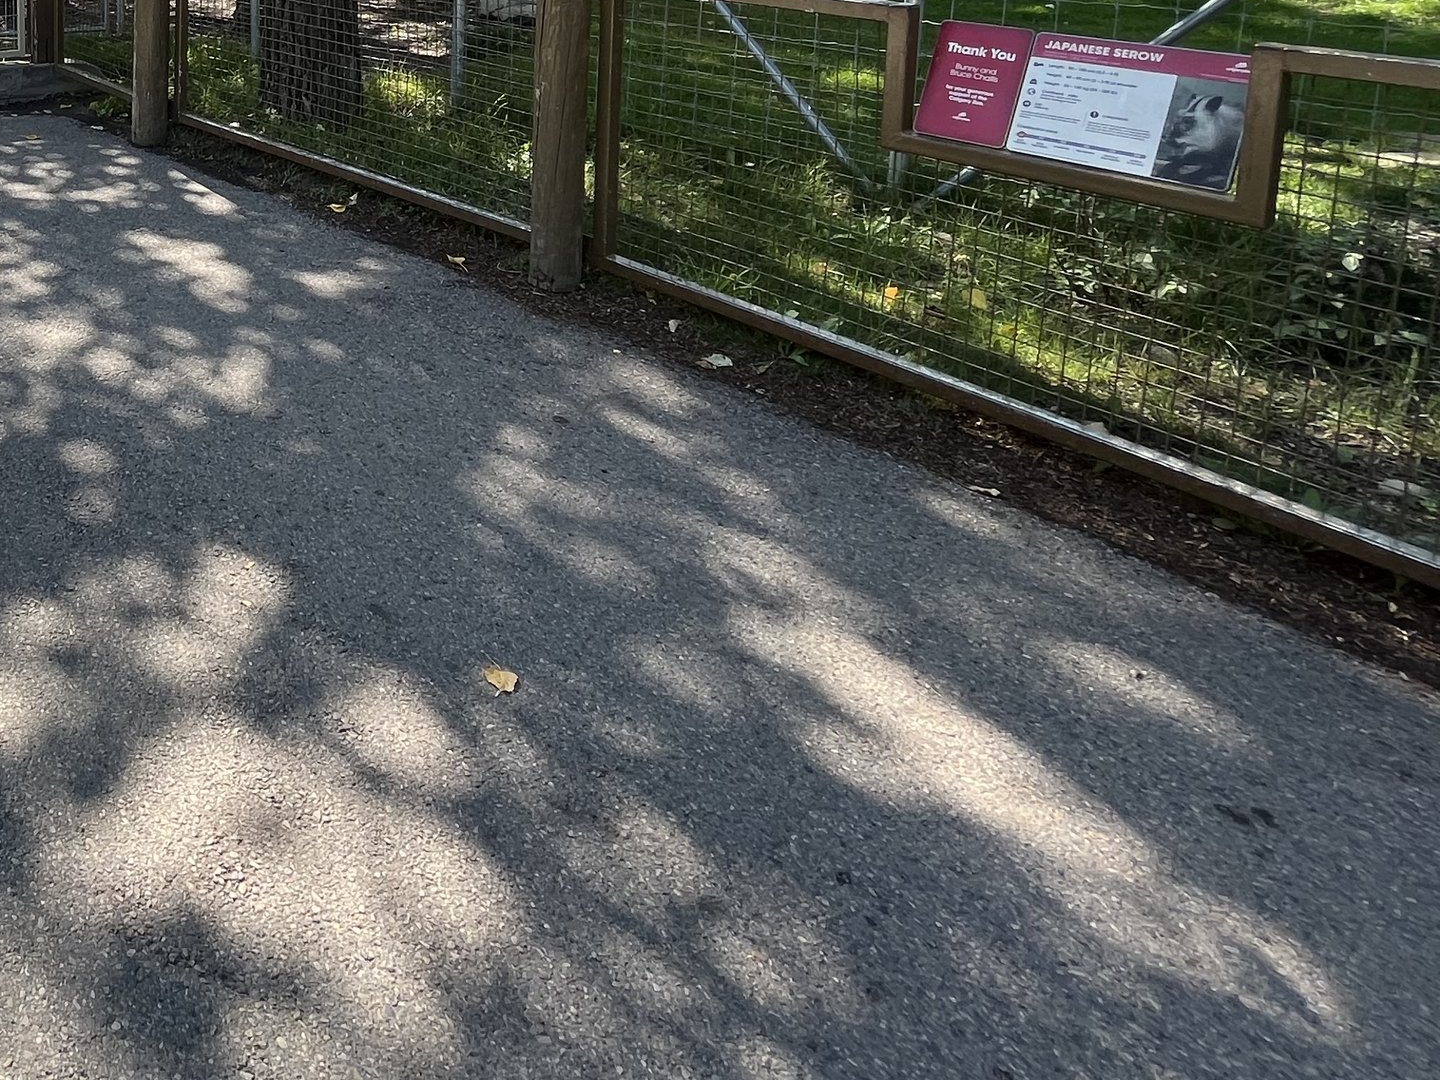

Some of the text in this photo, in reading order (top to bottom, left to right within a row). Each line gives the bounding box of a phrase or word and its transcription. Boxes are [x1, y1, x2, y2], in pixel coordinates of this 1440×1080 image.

[947, 41, 1016, 62] Thank You
[1044, 40, 1111, 56] JAPANESE
[1113, 48, 1164, 62] SEROW
[950, 69, 972, 78] Bruce
[955, 62, 997, 75] Bunny and
